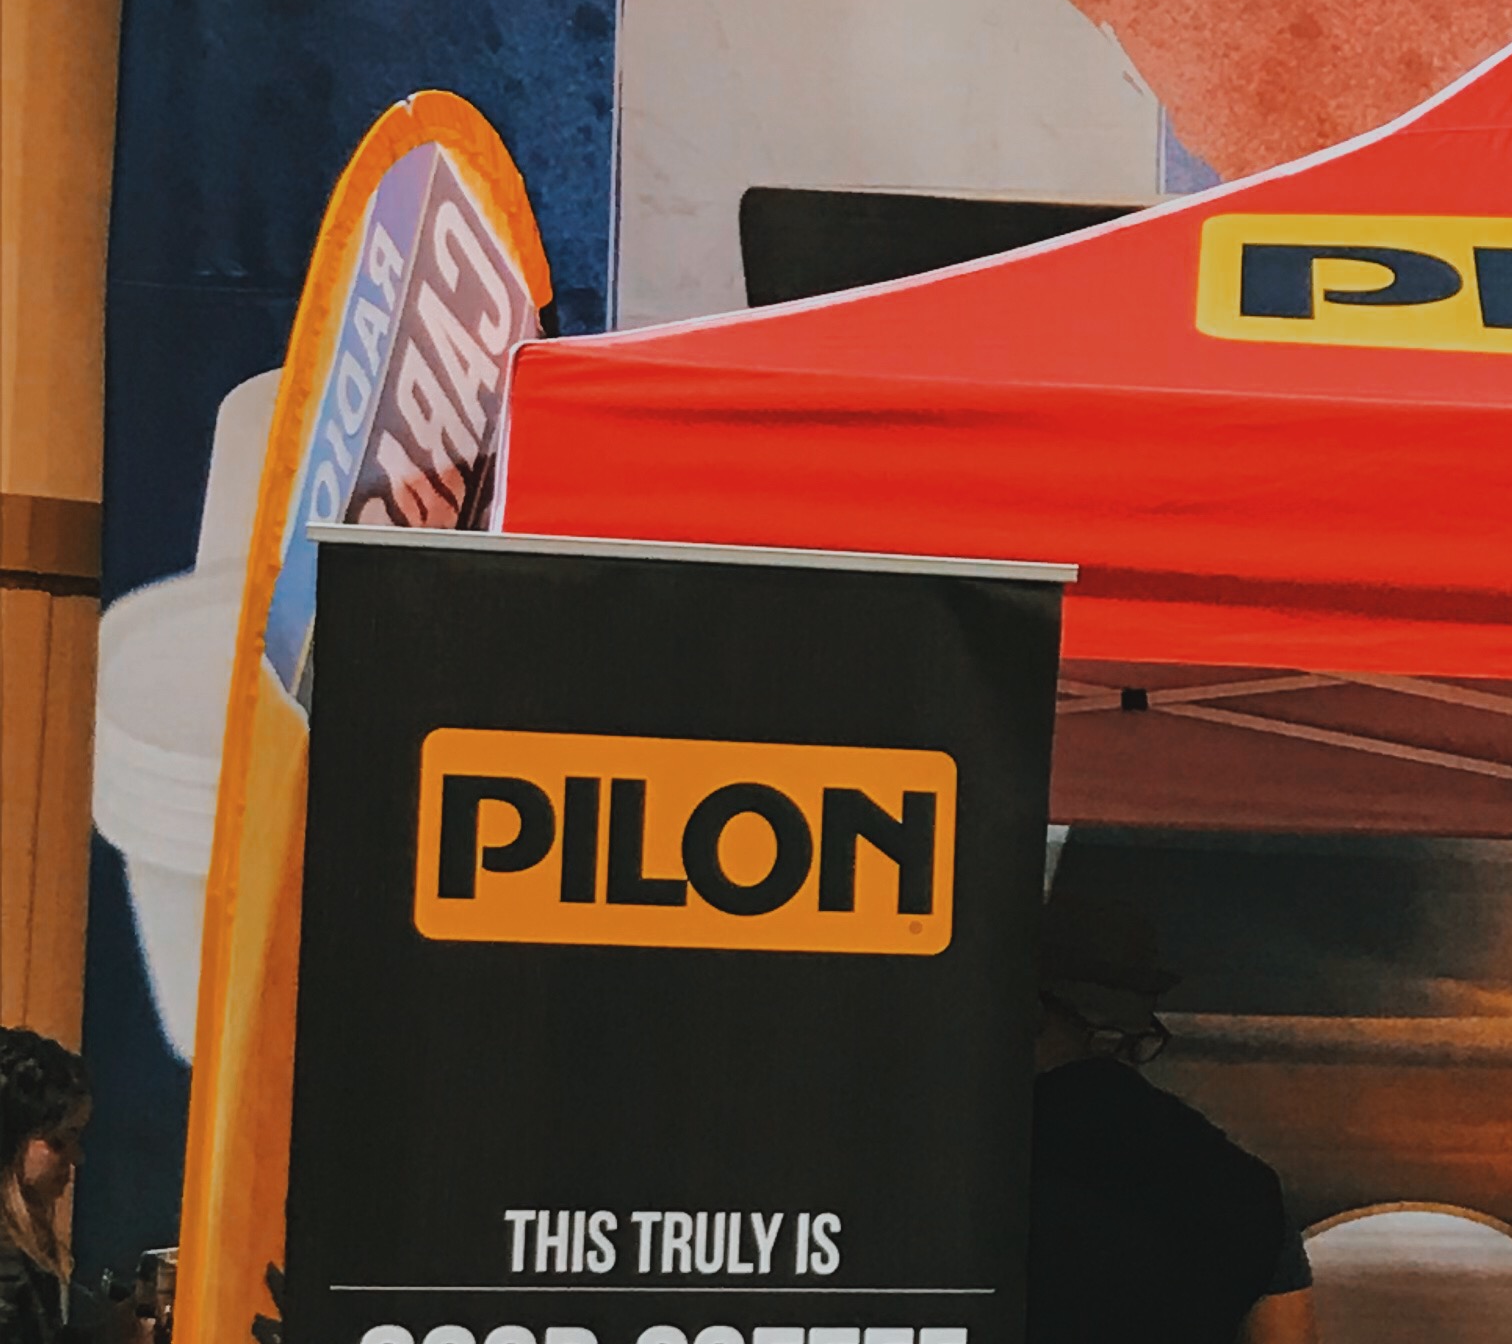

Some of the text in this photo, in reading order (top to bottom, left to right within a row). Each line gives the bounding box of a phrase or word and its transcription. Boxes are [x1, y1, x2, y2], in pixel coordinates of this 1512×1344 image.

[437, 773, 939, 917] PILON
[504, 1209, 842, 1276] THIS TRULY IS
